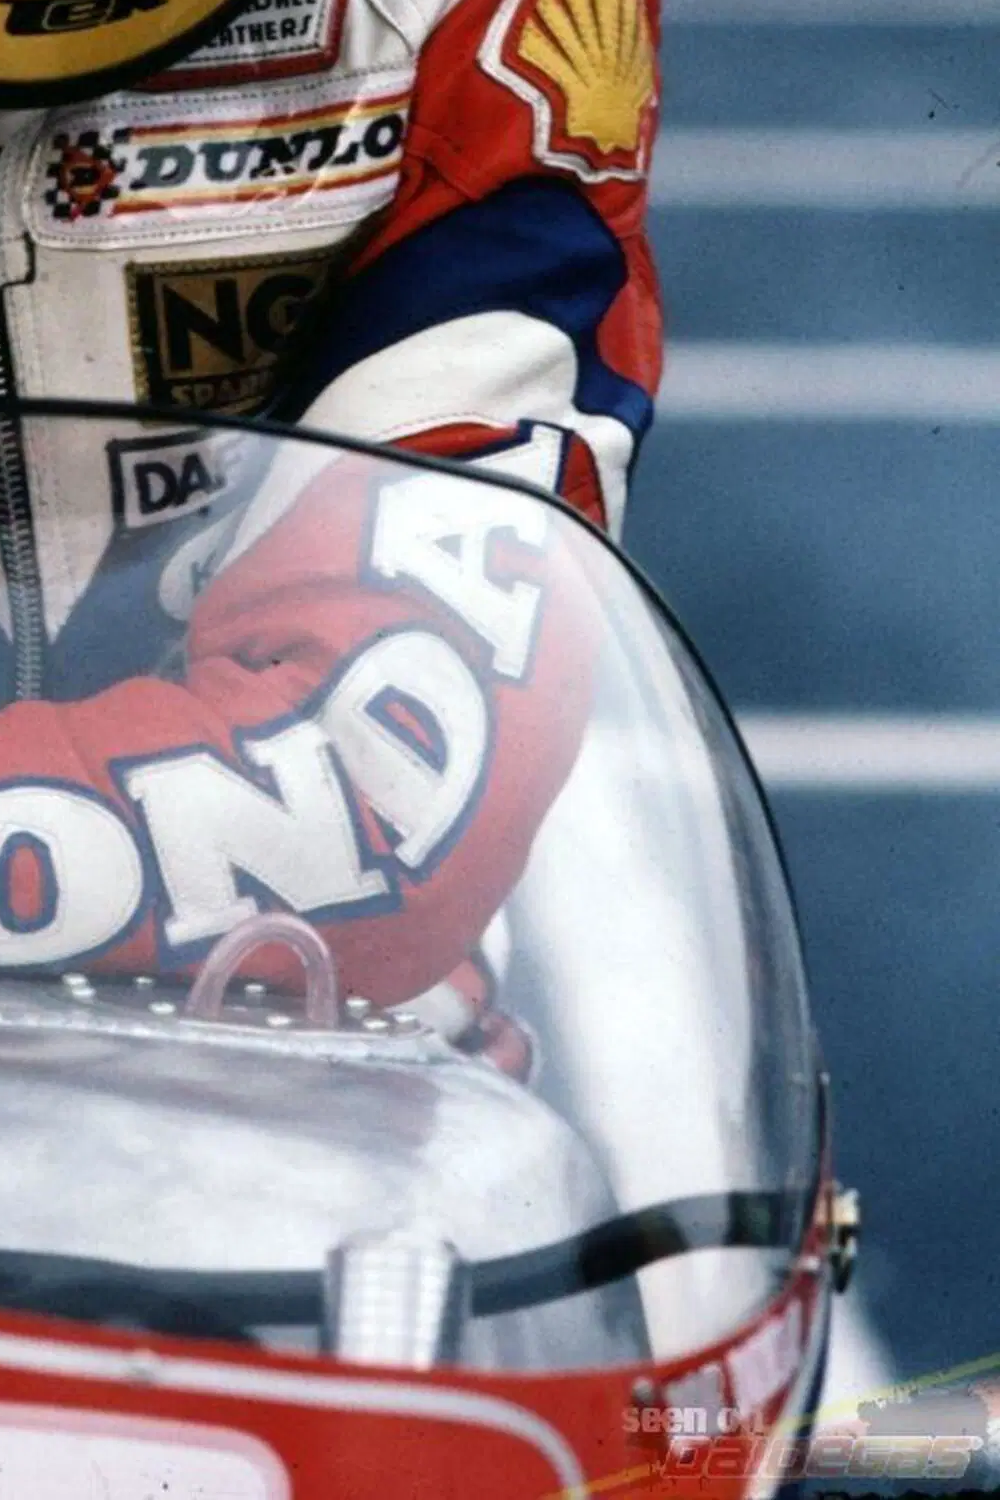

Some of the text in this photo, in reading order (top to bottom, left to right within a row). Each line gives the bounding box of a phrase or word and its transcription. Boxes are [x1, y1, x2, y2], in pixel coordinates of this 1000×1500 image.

[211, 14, 314, 48] ATHERS
[129, 113, 404, 191] DUNLO
[162, 272, 316, 370] NG
